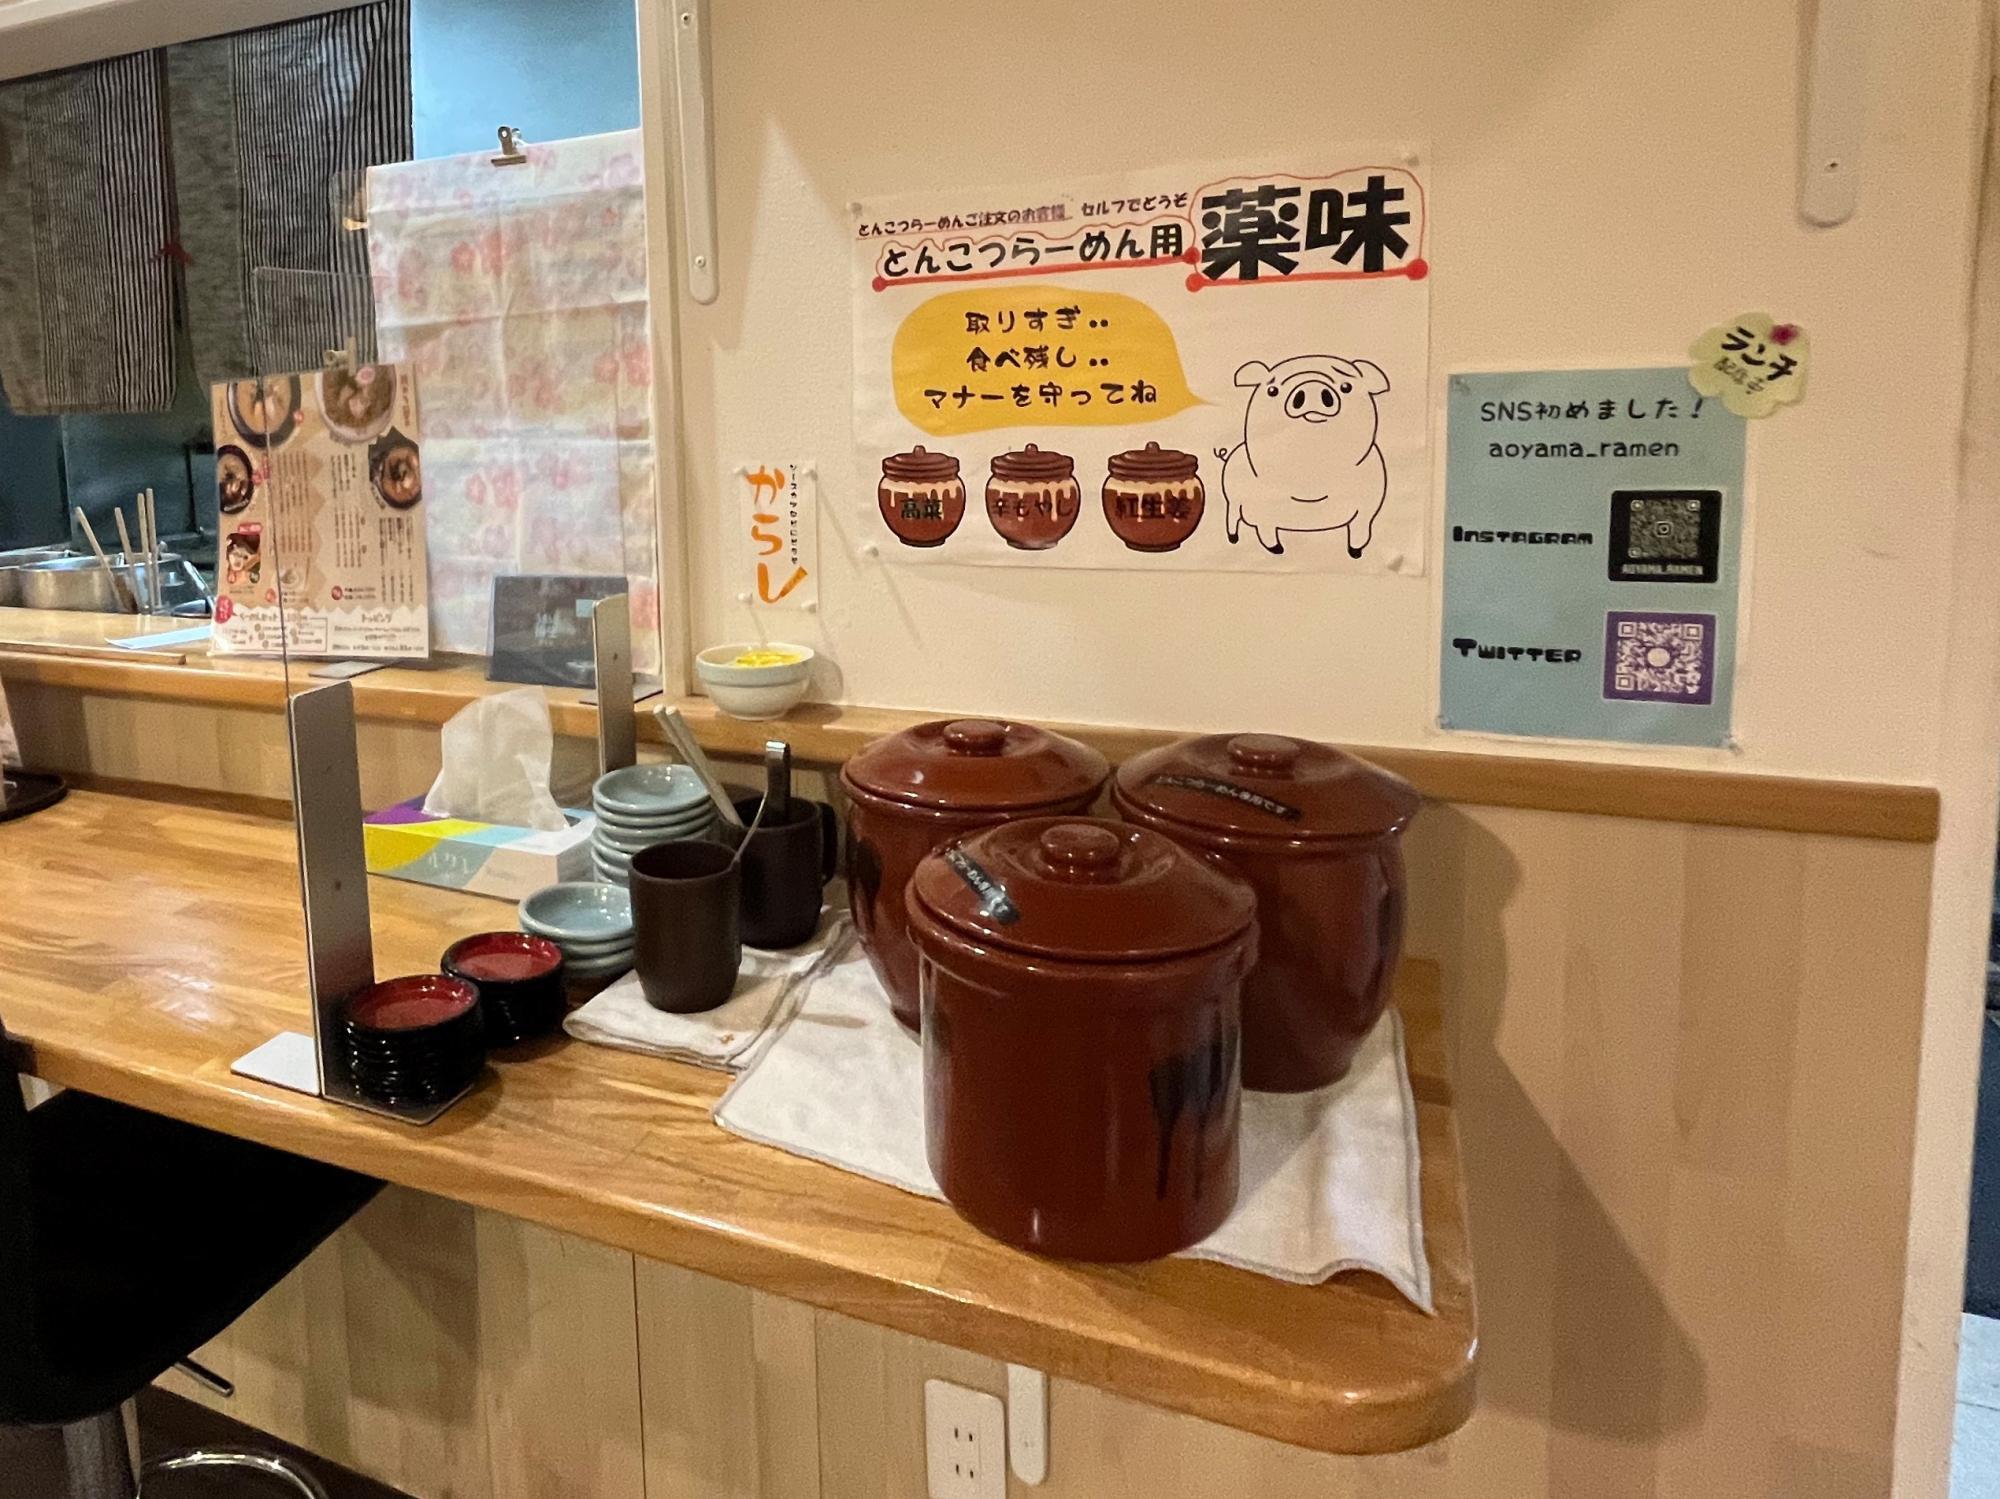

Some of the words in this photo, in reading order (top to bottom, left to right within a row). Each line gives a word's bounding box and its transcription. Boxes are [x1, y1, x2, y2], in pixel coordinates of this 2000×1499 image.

[1081, 192, 1188, 217] セルフでどうぞ
[1200, 175, 1411, 281] 薬味
[882, 223, 1184, 278] とんこつらーめん用
[1721, 326, 1798, 381] ランチ
[924, 379, 1157, 409] マナーを守ってね
[1489, 441, 1680, 460] aoyama_ramen
[745, 464, 809, 604] からし
